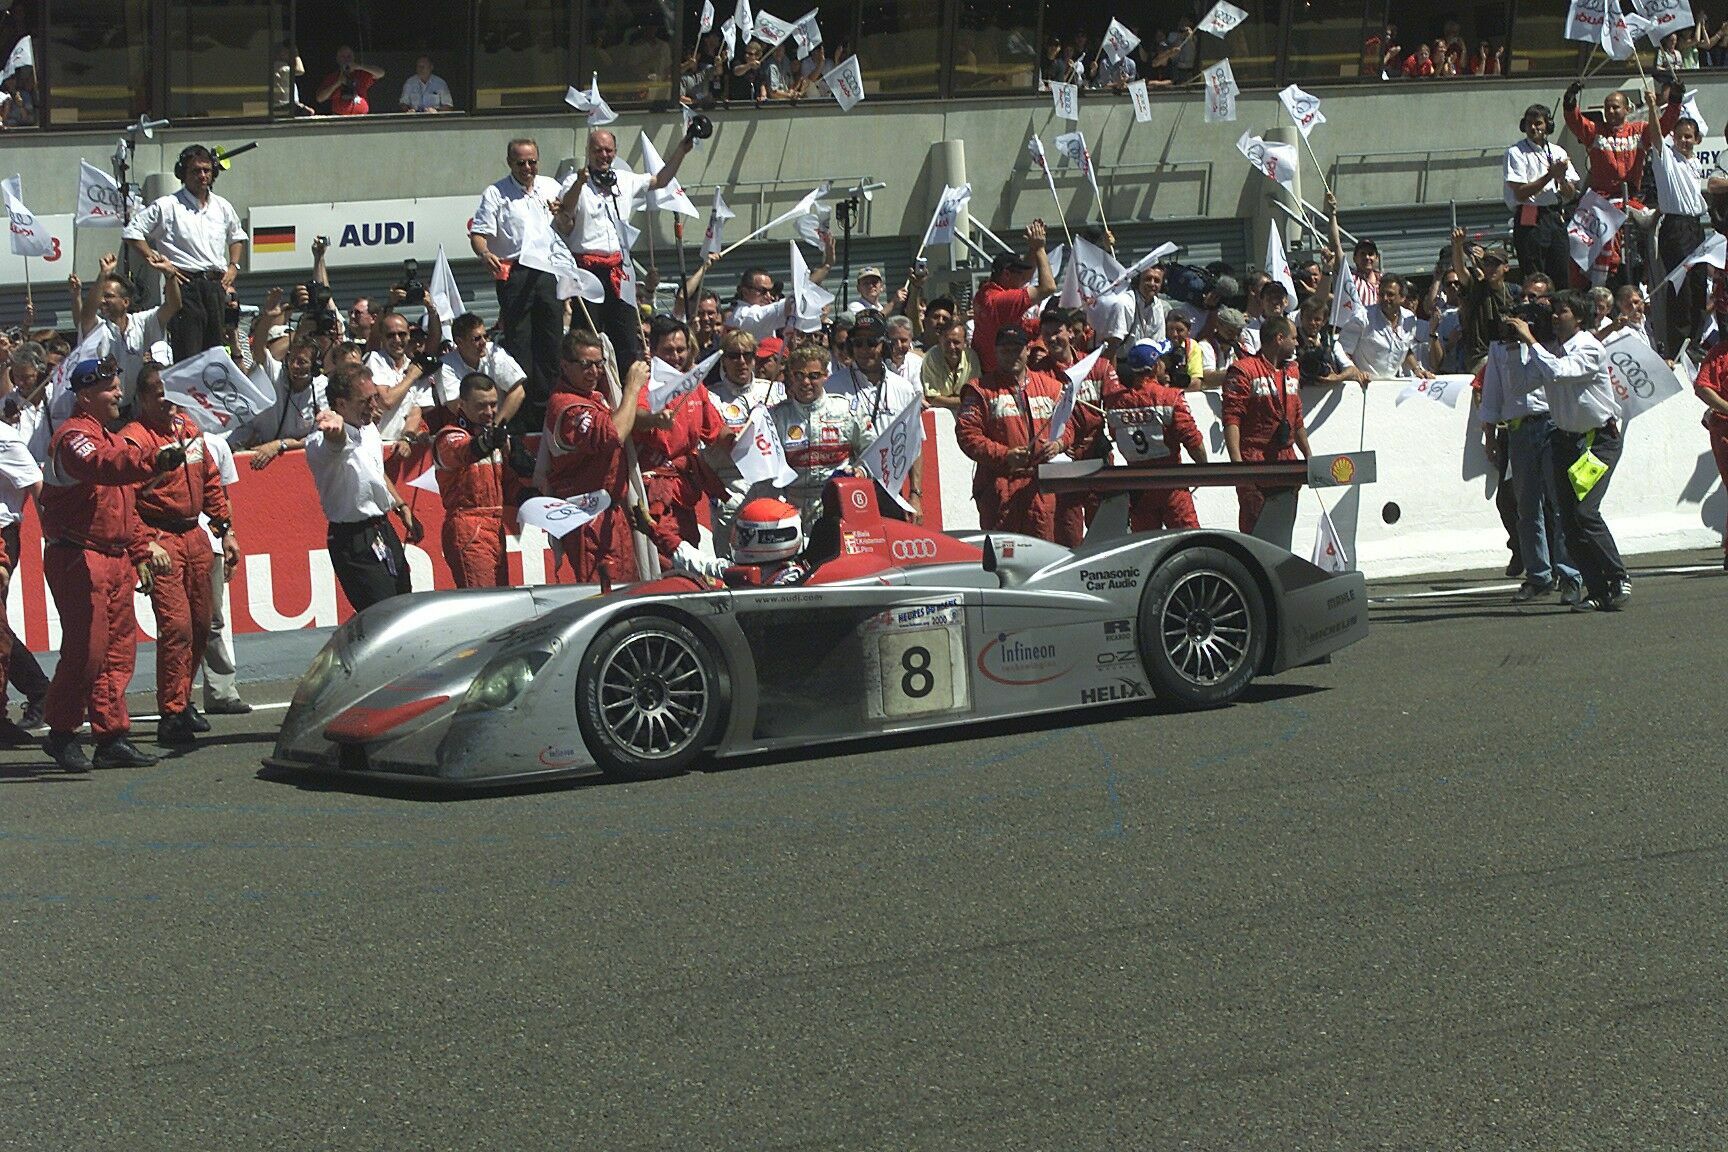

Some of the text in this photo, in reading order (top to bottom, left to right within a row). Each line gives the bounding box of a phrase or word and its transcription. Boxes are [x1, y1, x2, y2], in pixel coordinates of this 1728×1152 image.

[339, 221, 414, 248] AUDI
[1132, 429, 1150, 455] 9
[1080, 566, 1140, 582] Panasonic
[1086, 579, 1137, 591] Car Audio
[755, 594, 823, 604] www.audi.com
[898, 607, 925, 623] HEURES
[931, 614, 948, 625] 2000
[1001, 641, 1056, 664] Infineon
[902, 646, 935, 699] 8
[1081, 681, 1147, 704] HELIX
